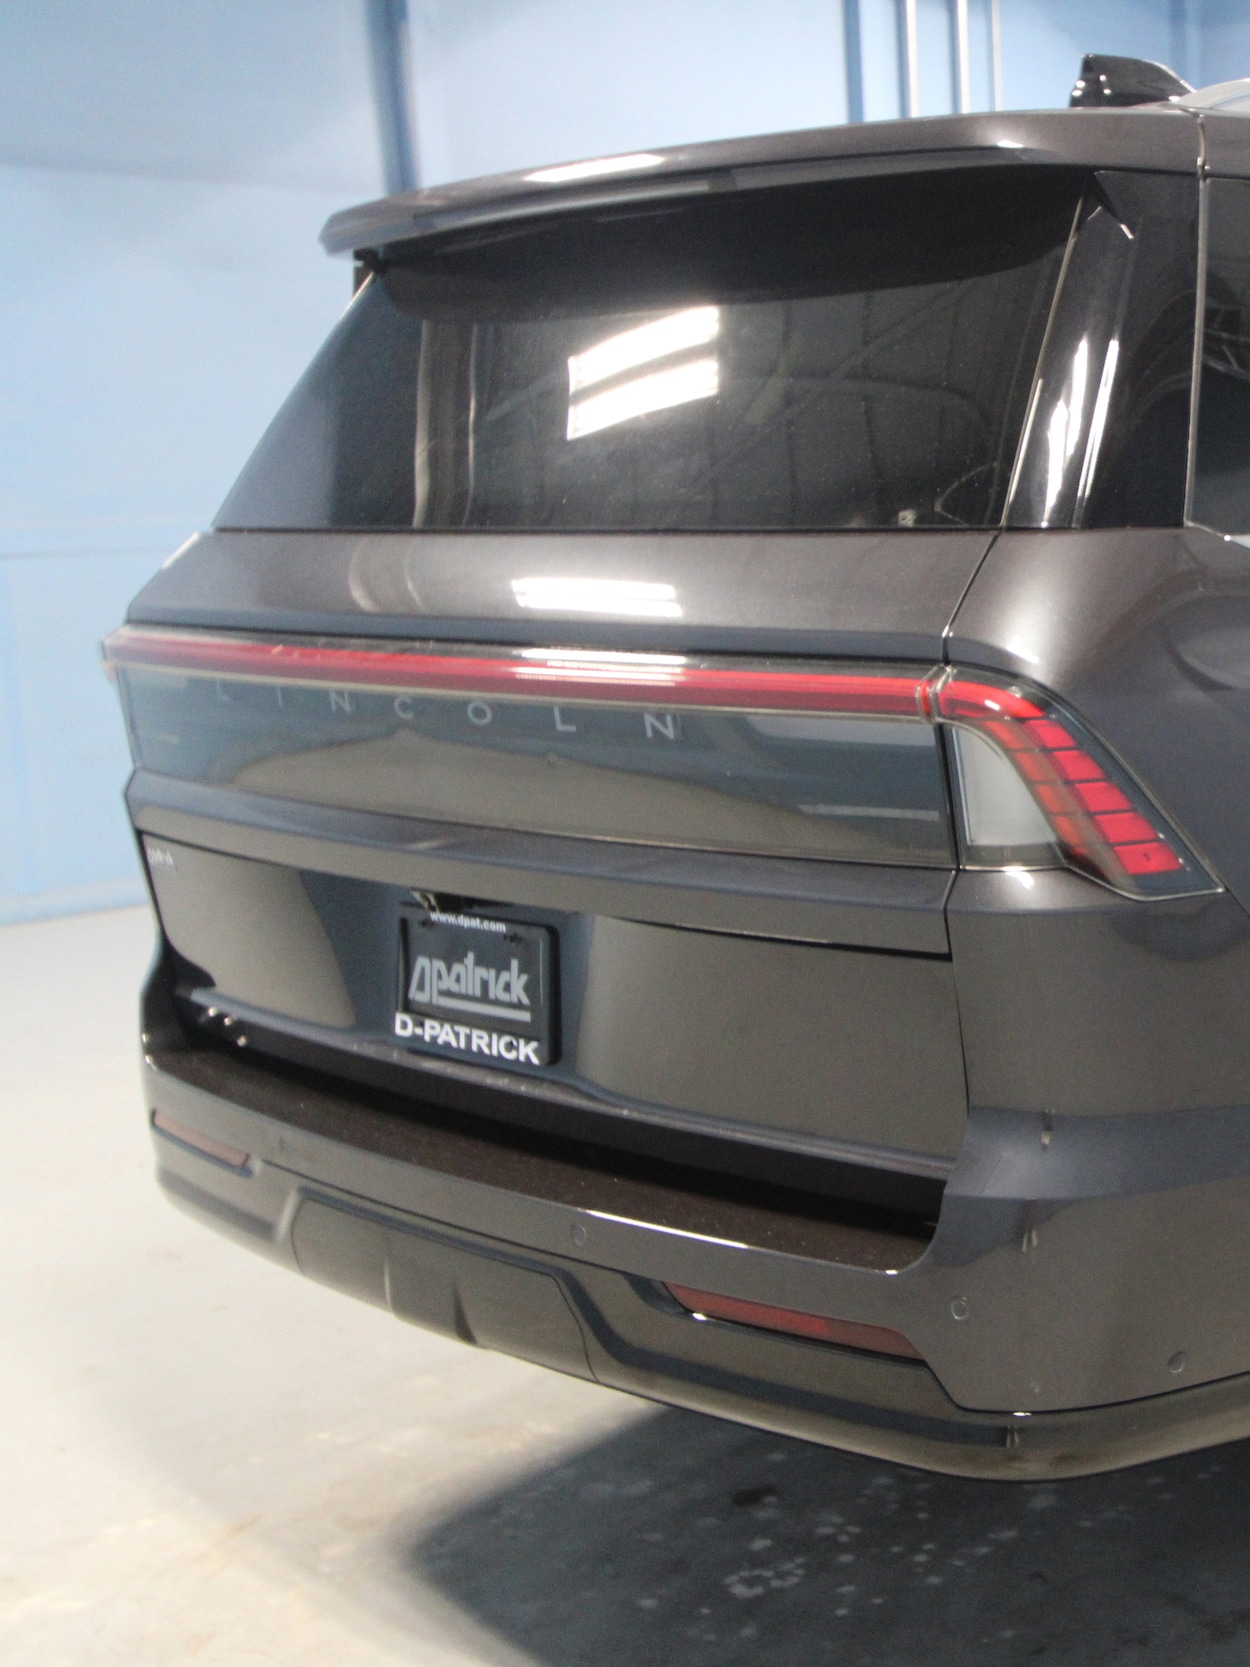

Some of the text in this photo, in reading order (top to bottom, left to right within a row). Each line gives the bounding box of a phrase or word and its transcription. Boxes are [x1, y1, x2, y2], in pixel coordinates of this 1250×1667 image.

[216, 680, 675, 741] LINCOLN
[430, 911, 507, 933] www.dpat.com
[394, 1012, 540, 1066] D-PATRICK
